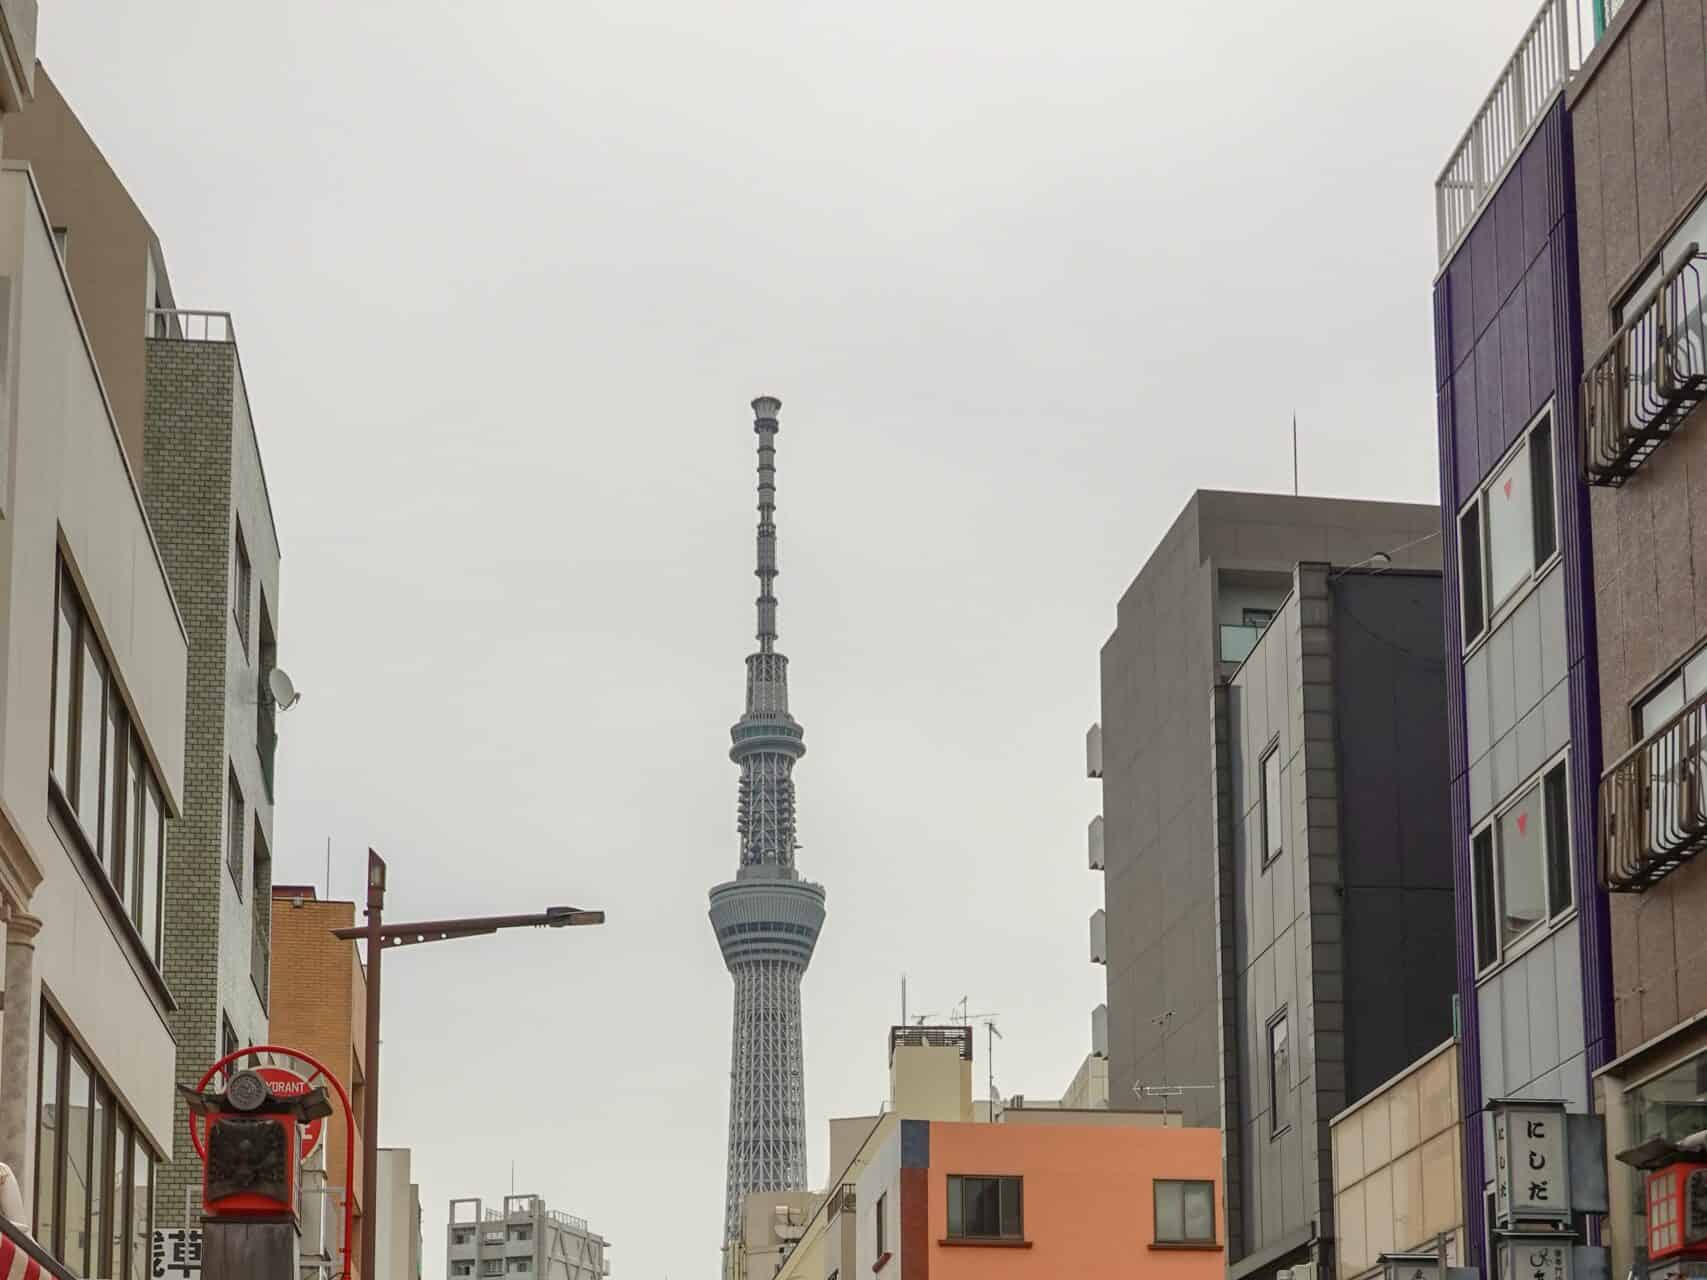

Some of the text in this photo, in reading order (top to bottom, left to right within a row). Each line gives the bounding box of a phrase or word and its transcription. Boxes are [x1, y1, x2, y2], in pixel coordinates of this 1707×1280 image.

[265, 1081, 305, 1093] YDRANT
[1527, 1120, 1549, 1201] にしだ
